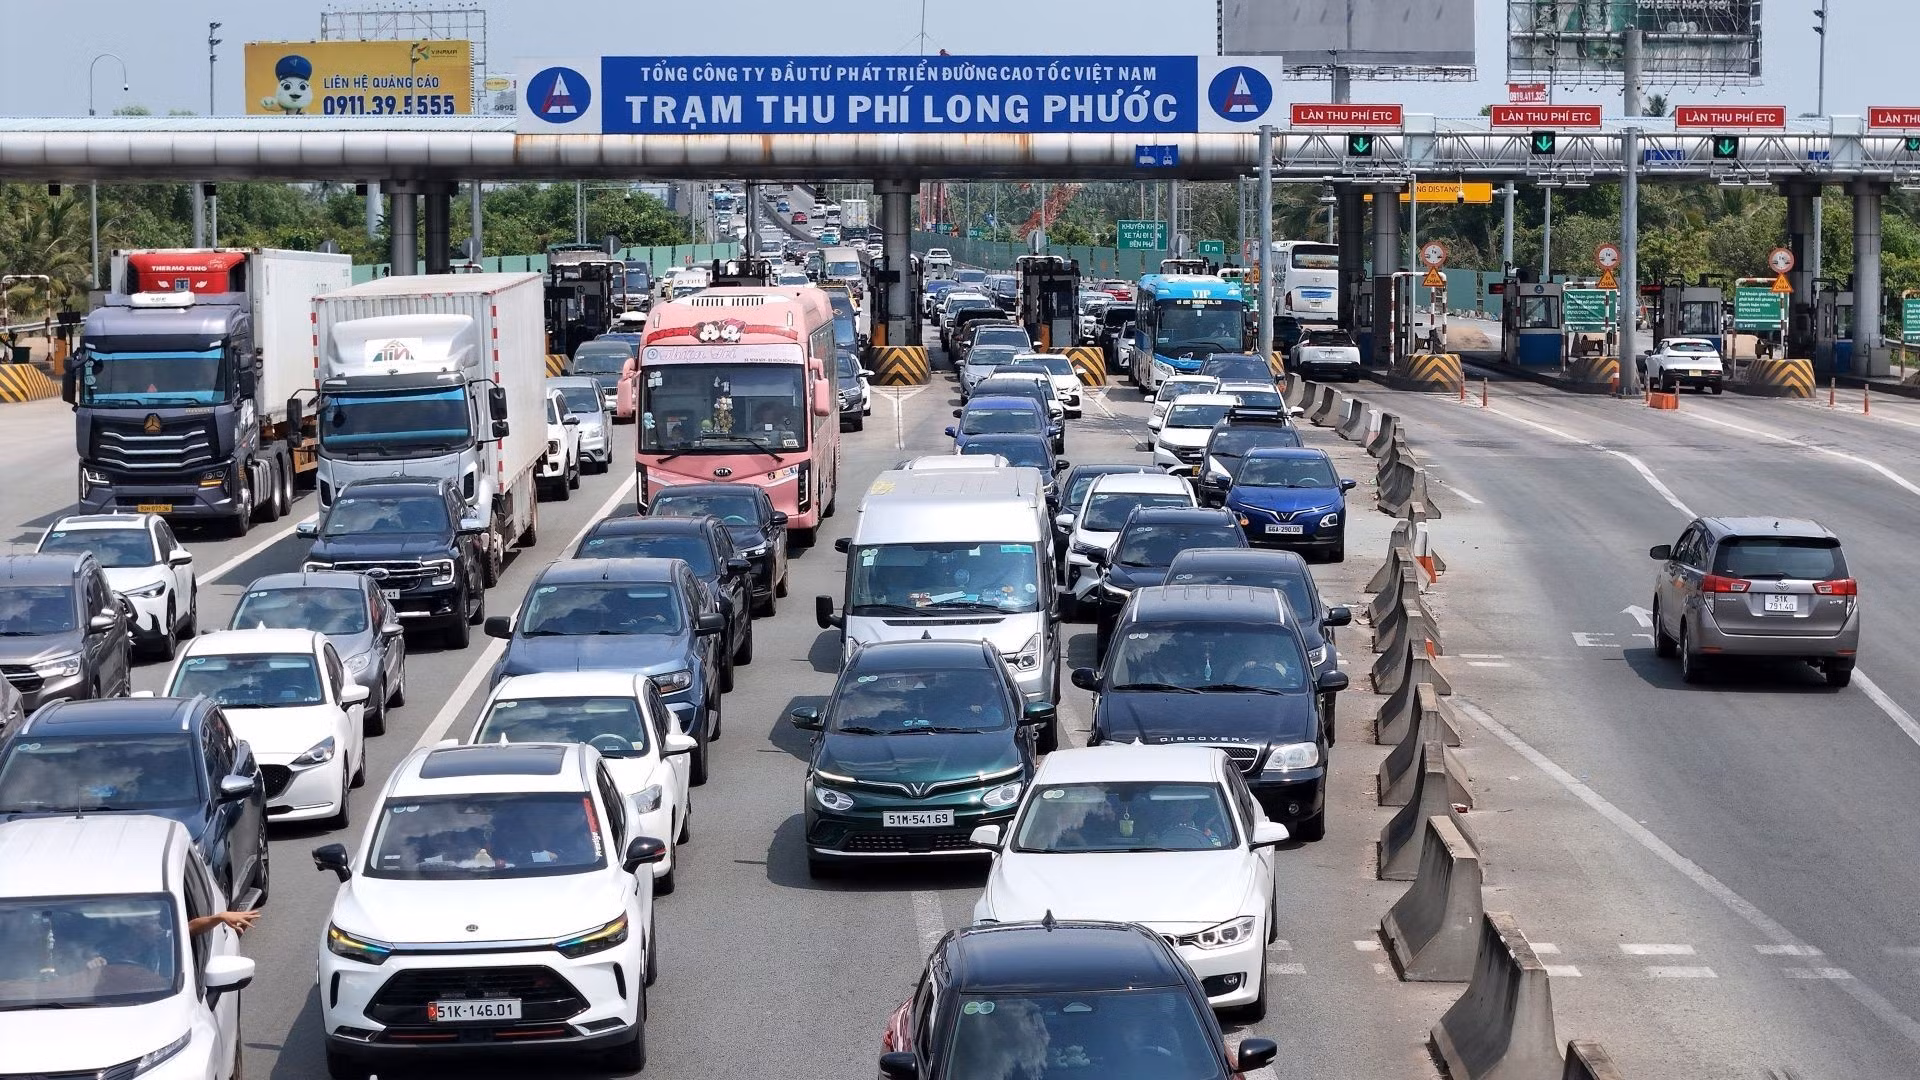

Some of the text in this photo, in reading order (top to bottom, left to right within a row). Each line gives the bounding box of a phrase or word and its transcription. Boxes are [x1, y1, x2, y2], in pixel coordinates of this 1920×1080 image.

[641, 59, 1157, 84] TỔNG CÔNG TY ĐẦU TƯ PHÁT TRIỂN ĐƯỜNG CAO TỐC VIỆT NAM
[323, 73, 439, 92] LIÊN HỆ QUẢNG CÁO
[323, 95, 455, 115] 0911.39.5555
[625, 84, 1177, 130] TRẠM THU PHÍ LONG PHƯỚC
[1301, 108, 1393, 121] LÀN THU PHÍ ETC
[1501, 109, 1592, 121] LÀN THU PHÍ ETC
[1685, 110, 1775, 122] LÀN THU PHÍ ETC
[1878, 112, 1902, 124] LÀN
[1428, 185, 1463, 193] DISTANC
[1205, 243, 1210, 252] 0
[1192, 289, 1211, 299] VIP
[1774, 595, 1788, 603] 51K
[1769, 602, 1794, 610] 791.40
[889, 812, 949, 826] 51M-541.69
[437, 1003, 513, 1018] 51K-146.01
